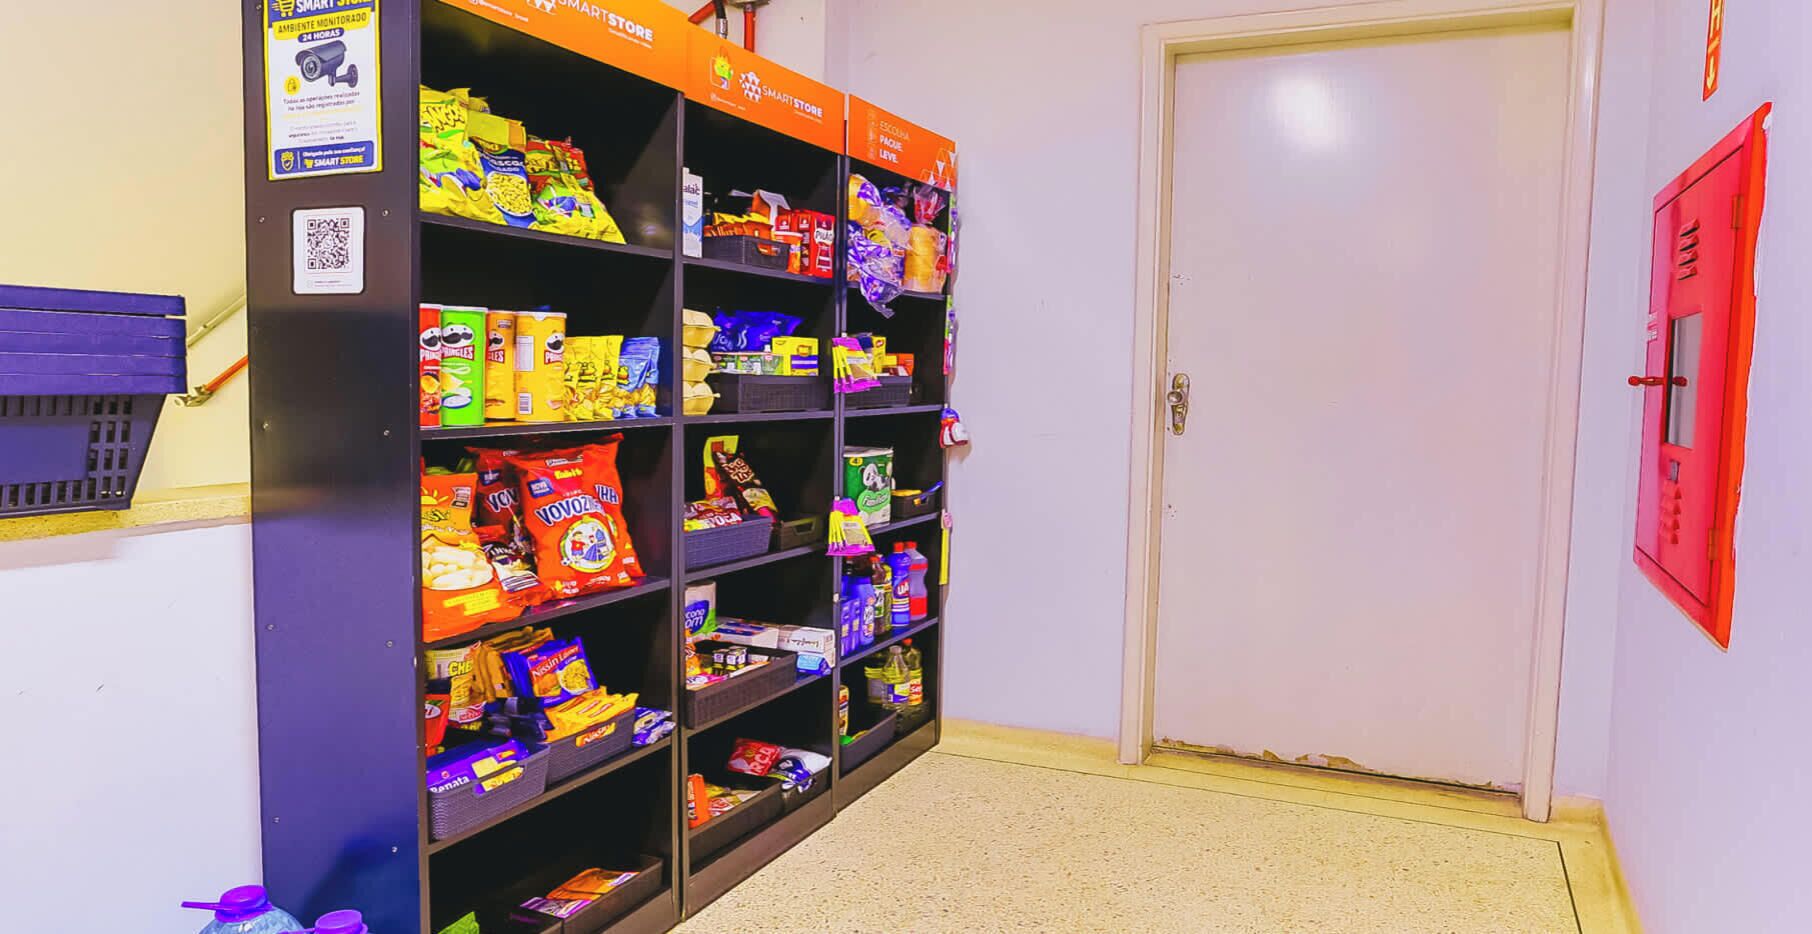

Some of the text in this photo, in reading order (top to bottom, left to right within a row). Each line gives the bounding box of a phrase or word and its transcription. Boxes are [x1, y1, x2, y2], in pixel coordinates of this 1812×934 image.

[278, 12, 367, 33] AMBIENTE MONITORADO
[302, 29, 341, 42] 24 HORAS
[313, 155, 364, 167] SMART STORE
[429, 775, 471, 793] Renata
